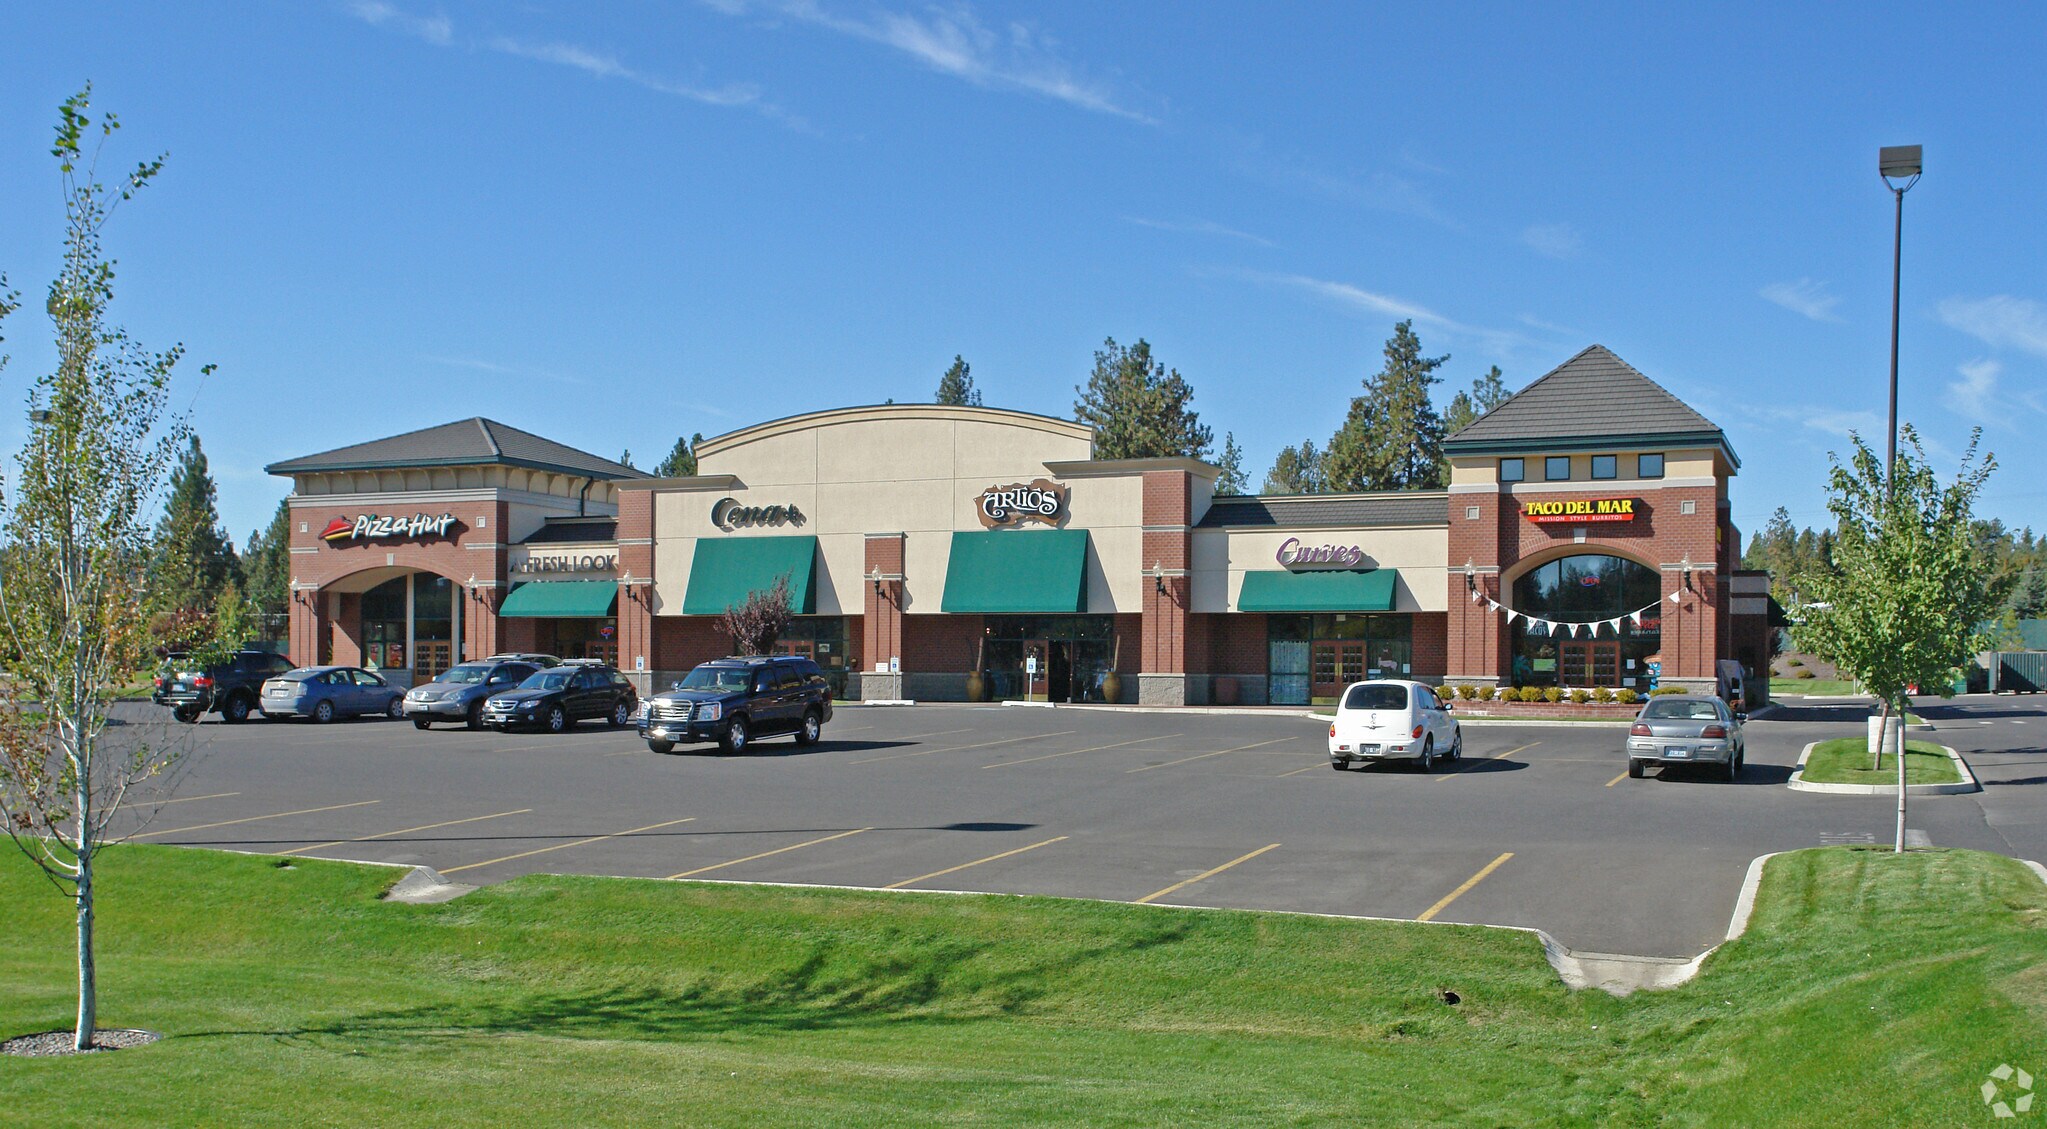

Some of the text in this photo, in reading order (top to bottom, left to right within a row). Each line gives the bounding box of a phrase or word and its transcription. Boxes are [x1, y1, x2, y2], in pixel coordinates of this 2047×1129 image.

[1526, 499, 1633, 515] TACO DEL MAR
[350, 512, 458, 540] Pizza Hut
[526, 555, 569, 572] FRESH
[572, 554, 618, 571] LOOK
[1275, 537, 1361, 567] Curves
